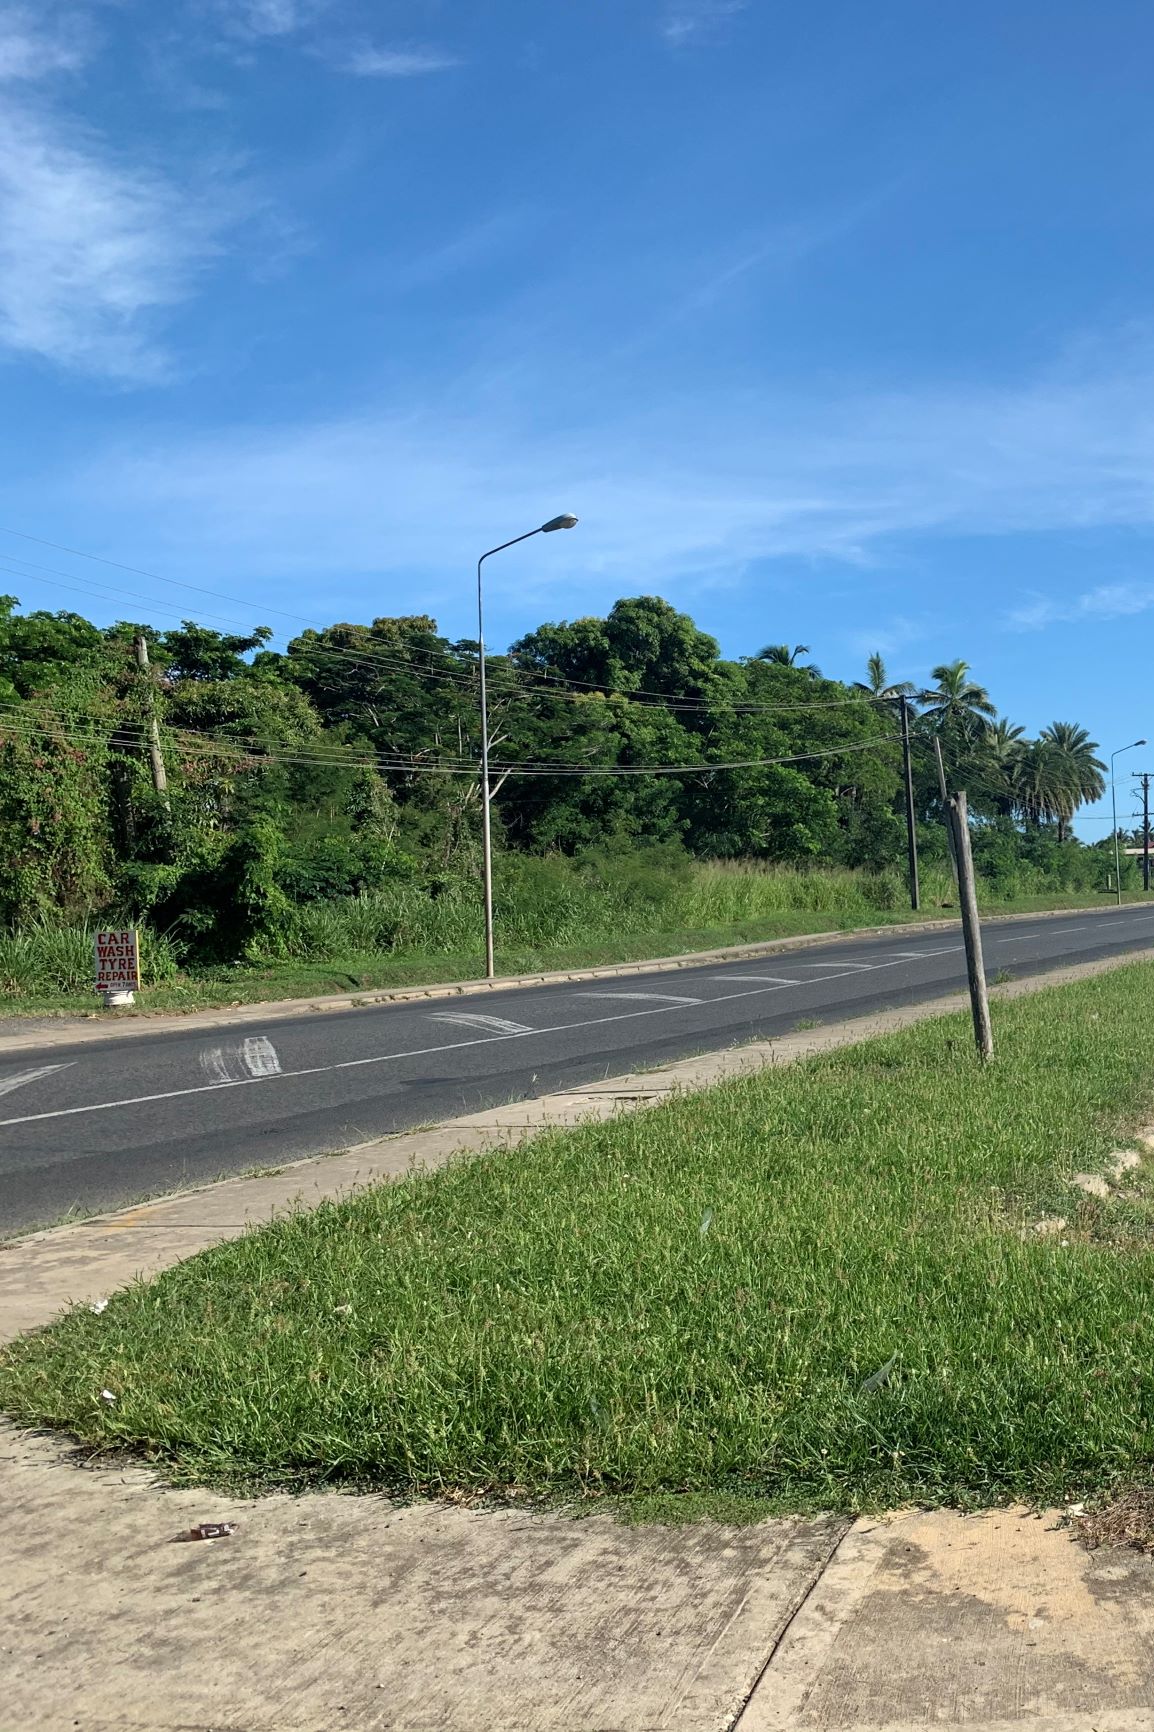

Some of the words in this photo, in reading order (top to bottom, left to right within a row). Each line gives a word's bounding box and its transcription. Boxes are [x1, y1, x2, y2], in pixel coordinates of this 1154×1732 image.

[98, 933, 129, 944] CAR
[97, 946, 134, 957] WASH
[99, 958, 135, 970] TYRE
[98, 971, 138, 981] REPAIR
